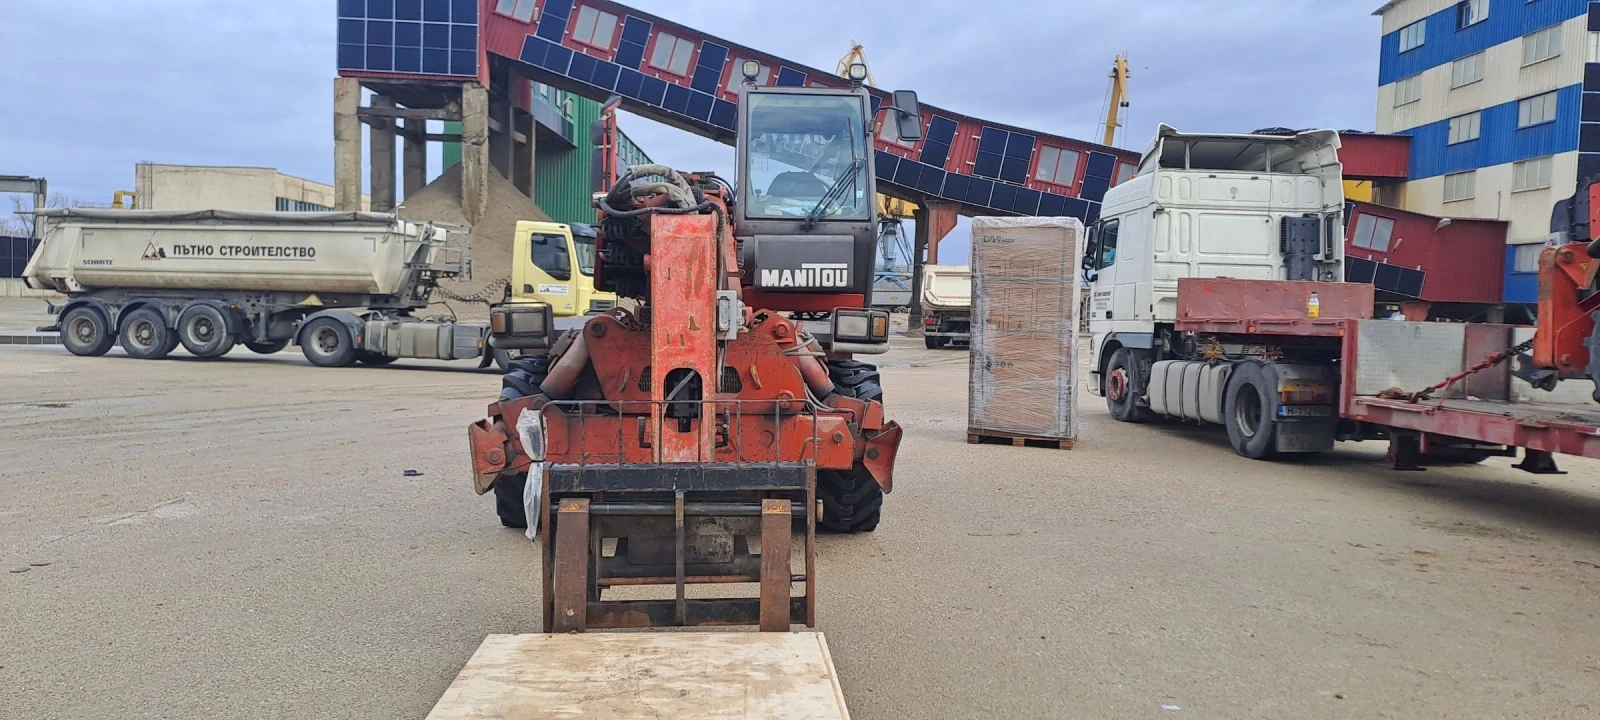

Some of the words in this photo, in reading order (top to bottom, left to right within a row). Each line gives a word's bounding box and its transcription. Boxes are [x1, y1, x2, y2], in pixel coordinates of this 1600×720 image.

[173, 245, 214, 256] ПЪТНО
[219, 245, 316, 258] СТРОИТЕЛСТВО
[761, 263, 848, 287] MANITOU
